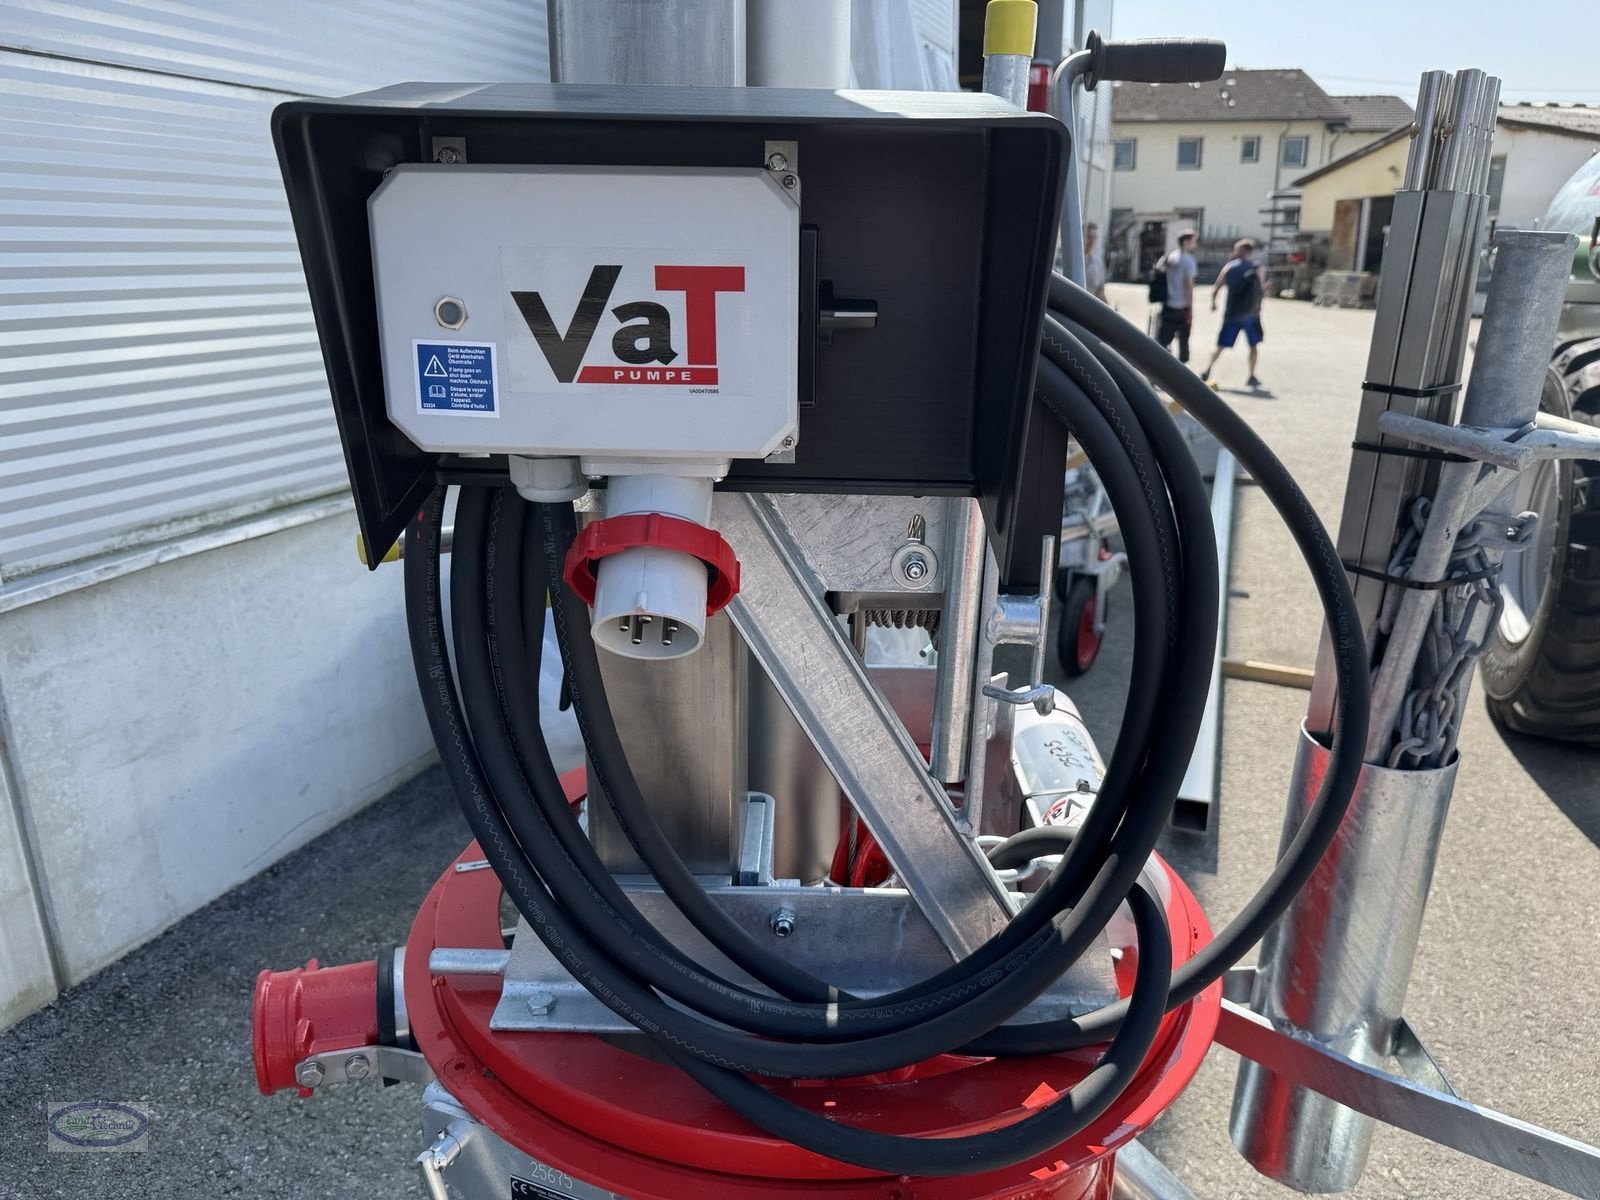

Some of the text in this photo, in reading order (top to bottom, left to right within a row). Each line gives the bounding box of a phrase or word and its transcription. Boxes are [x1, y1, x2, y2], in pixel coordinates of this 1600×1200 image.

[510, 265, 745, 383] VaT
[614, 370, 692, 381] PUMPE
[530, 1161, 573, 1190] 25675
